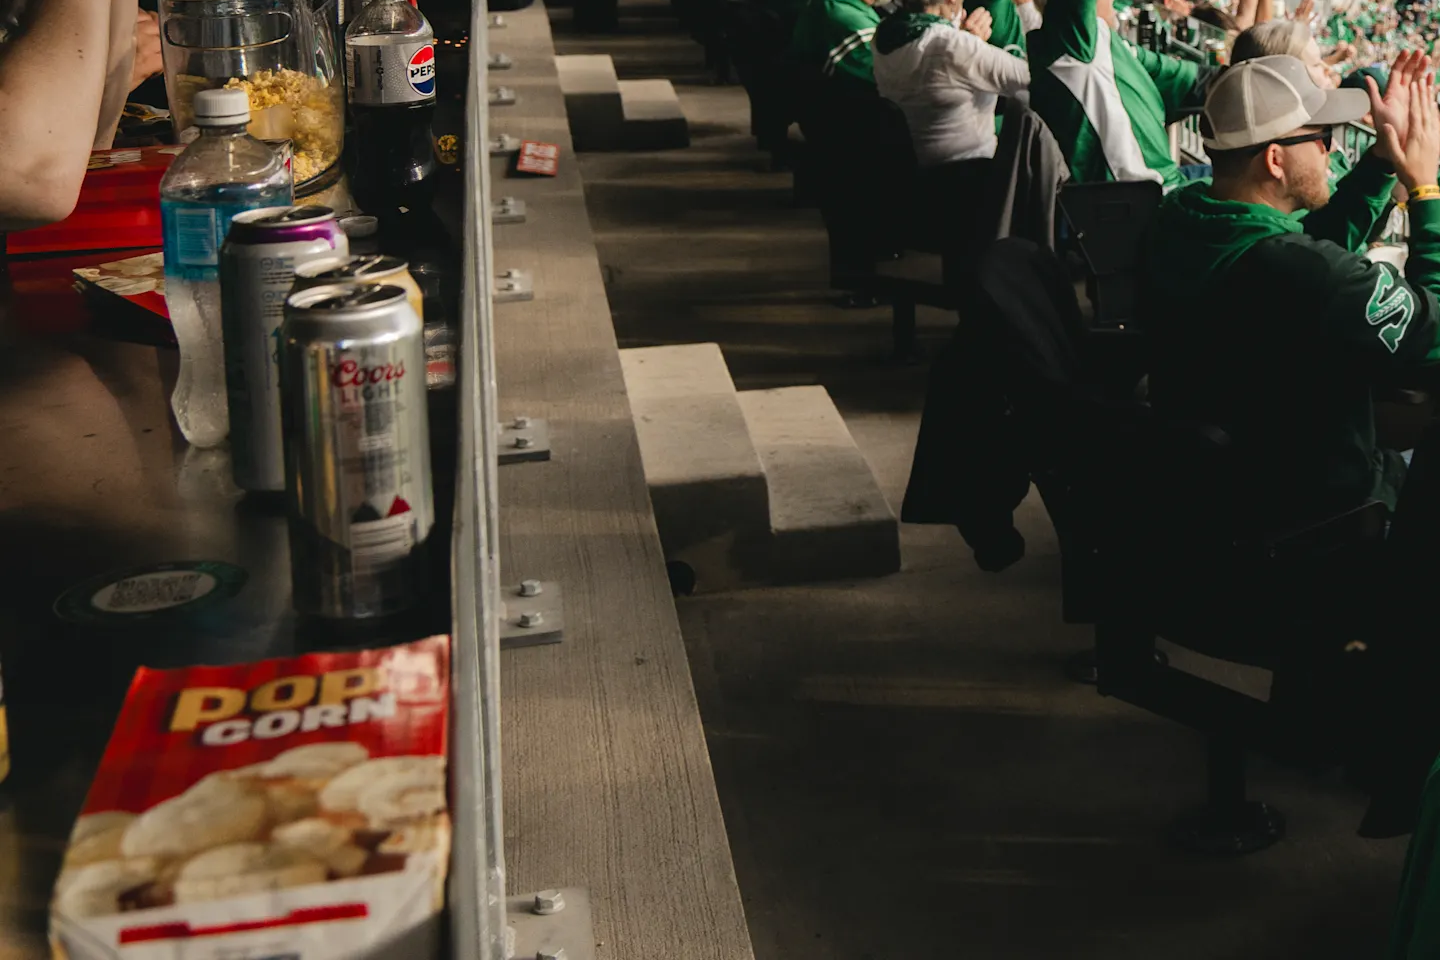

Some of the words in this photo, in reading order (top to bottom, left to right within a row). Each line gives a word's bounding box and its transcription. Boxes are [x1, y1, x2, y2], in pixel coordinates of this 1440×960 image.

[411, 63, 435, 78] PEPS
[333, 358, 406, 388] Coors
[169, 667, 382, 732] POP
[202, 692, 398, 746] CORN
